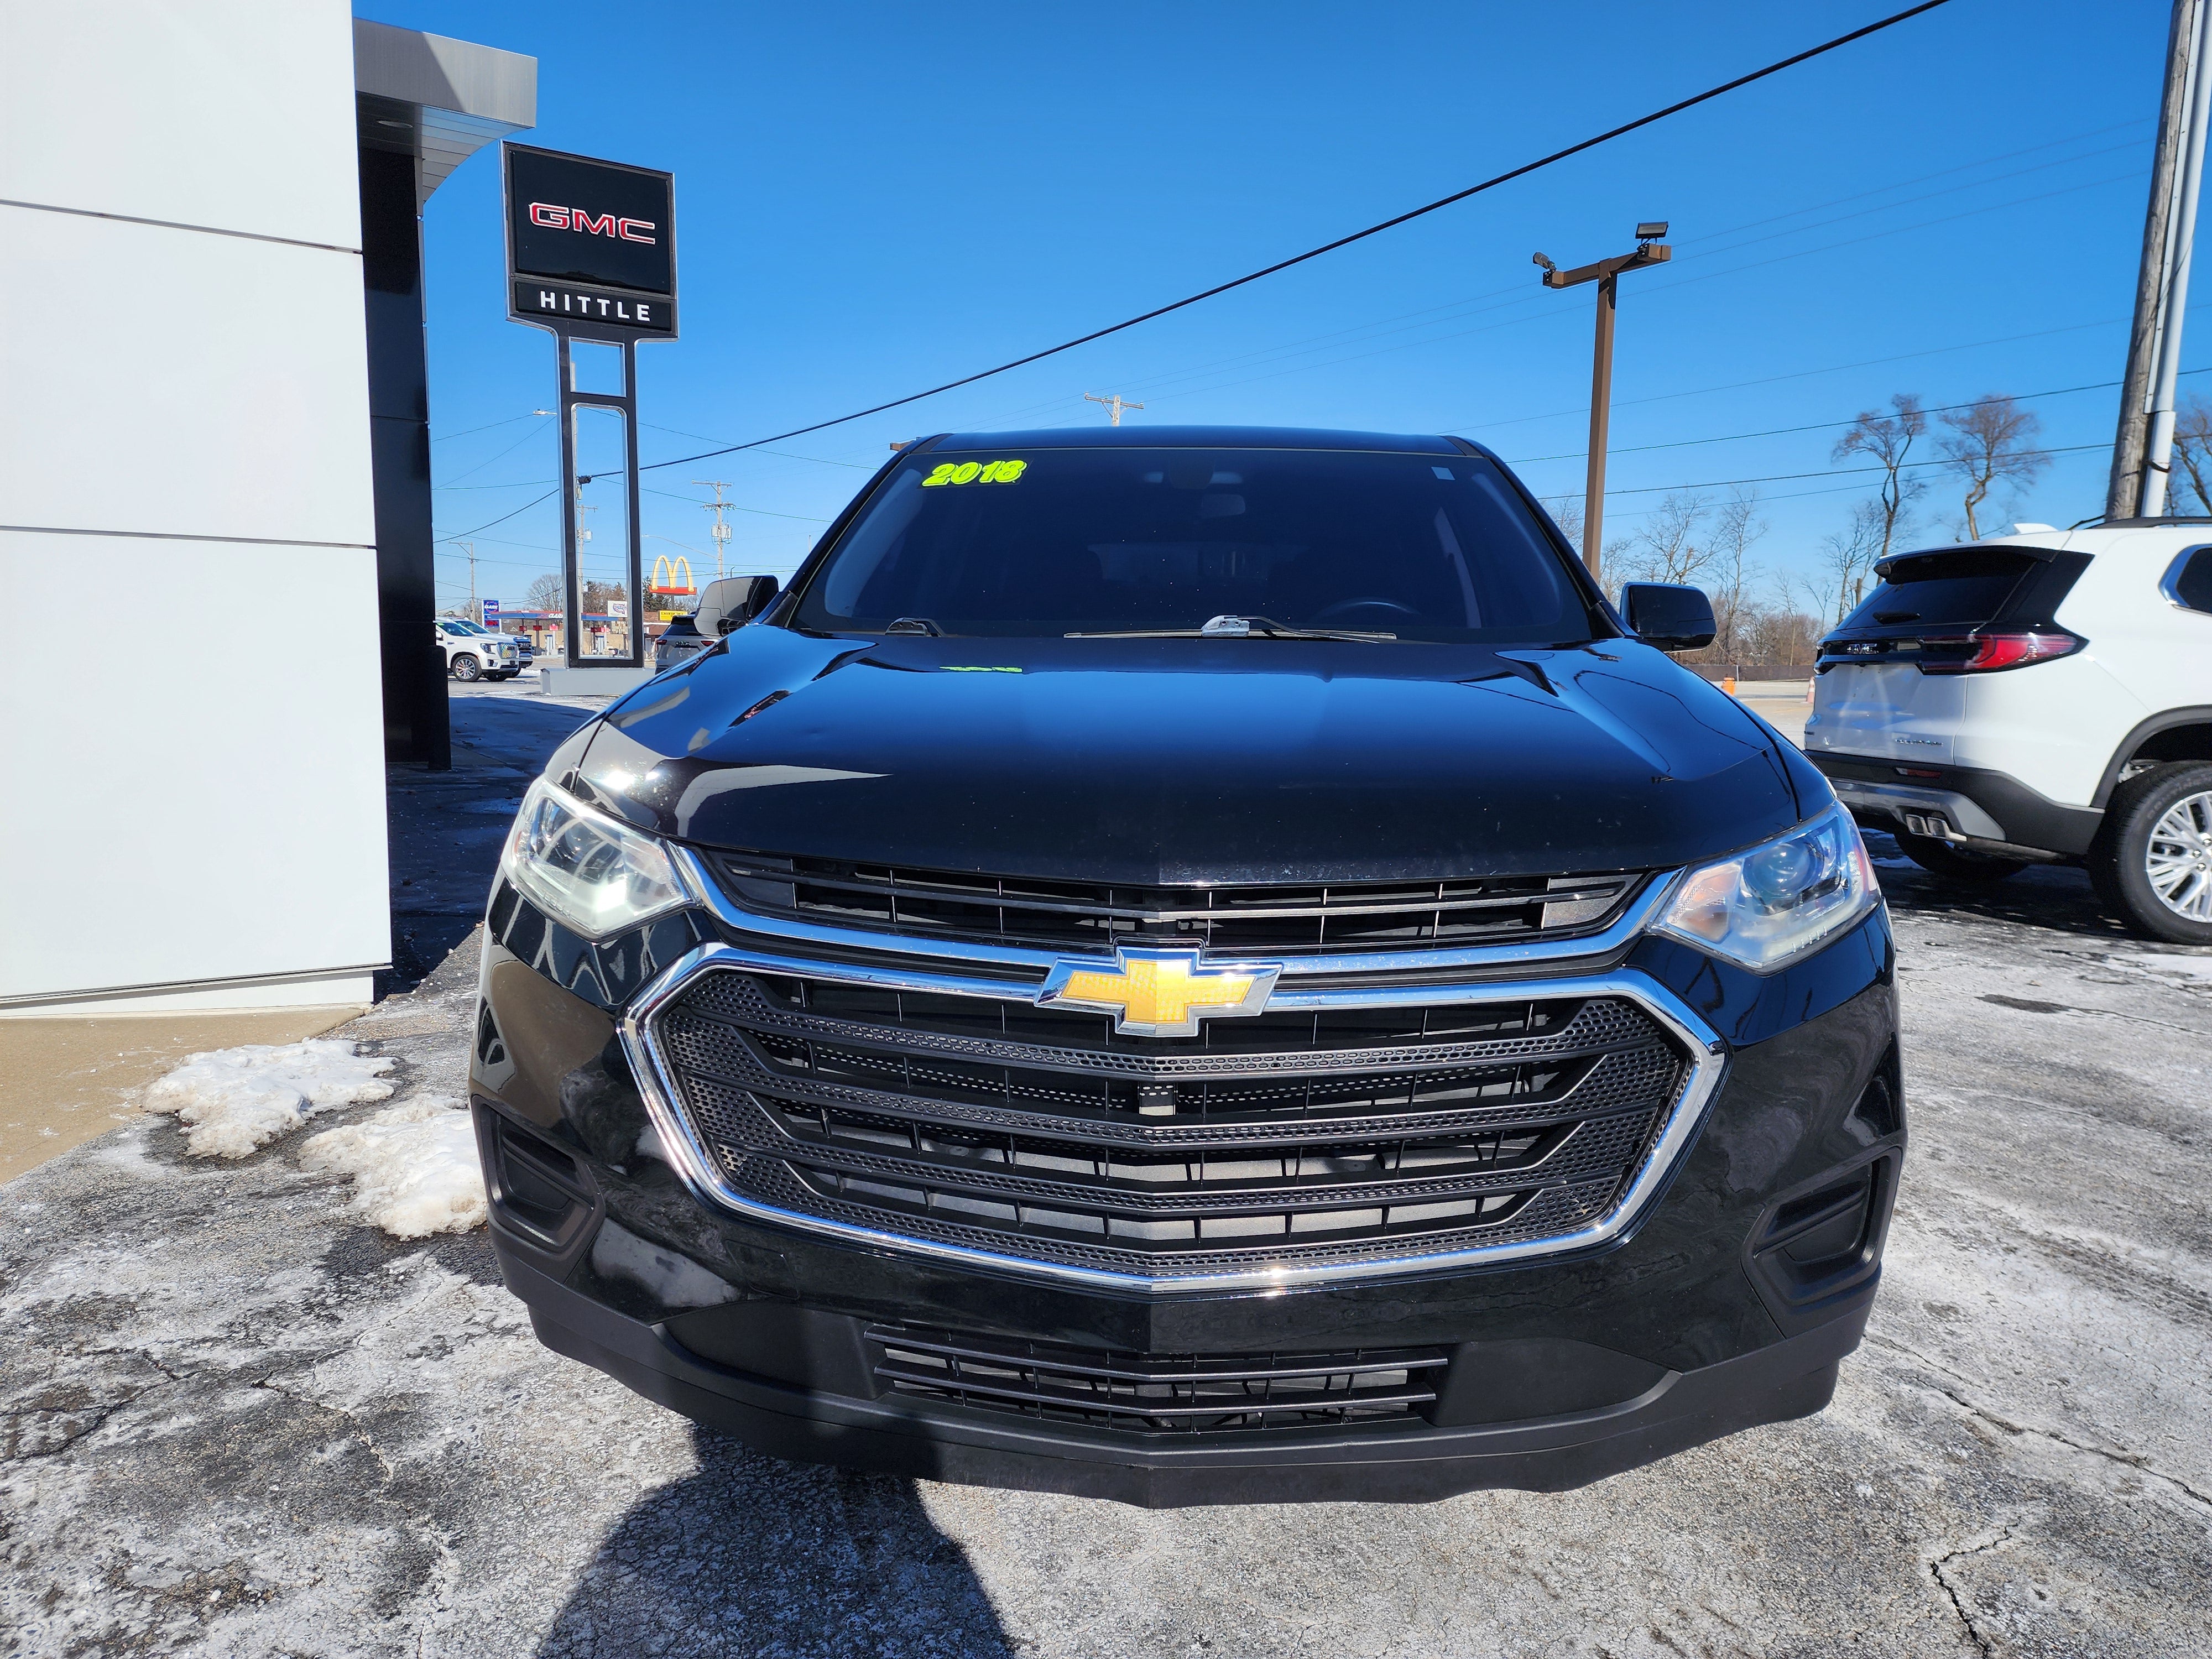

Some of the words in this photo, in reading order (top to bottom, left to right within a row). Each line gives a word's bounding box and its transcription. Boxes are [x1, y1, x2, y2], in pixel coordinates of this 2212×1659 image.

[529, 202, 655, 245] GMC
[540, 291, 650, 322] HITTLE
[922, 460, 1027, 487] 2018
